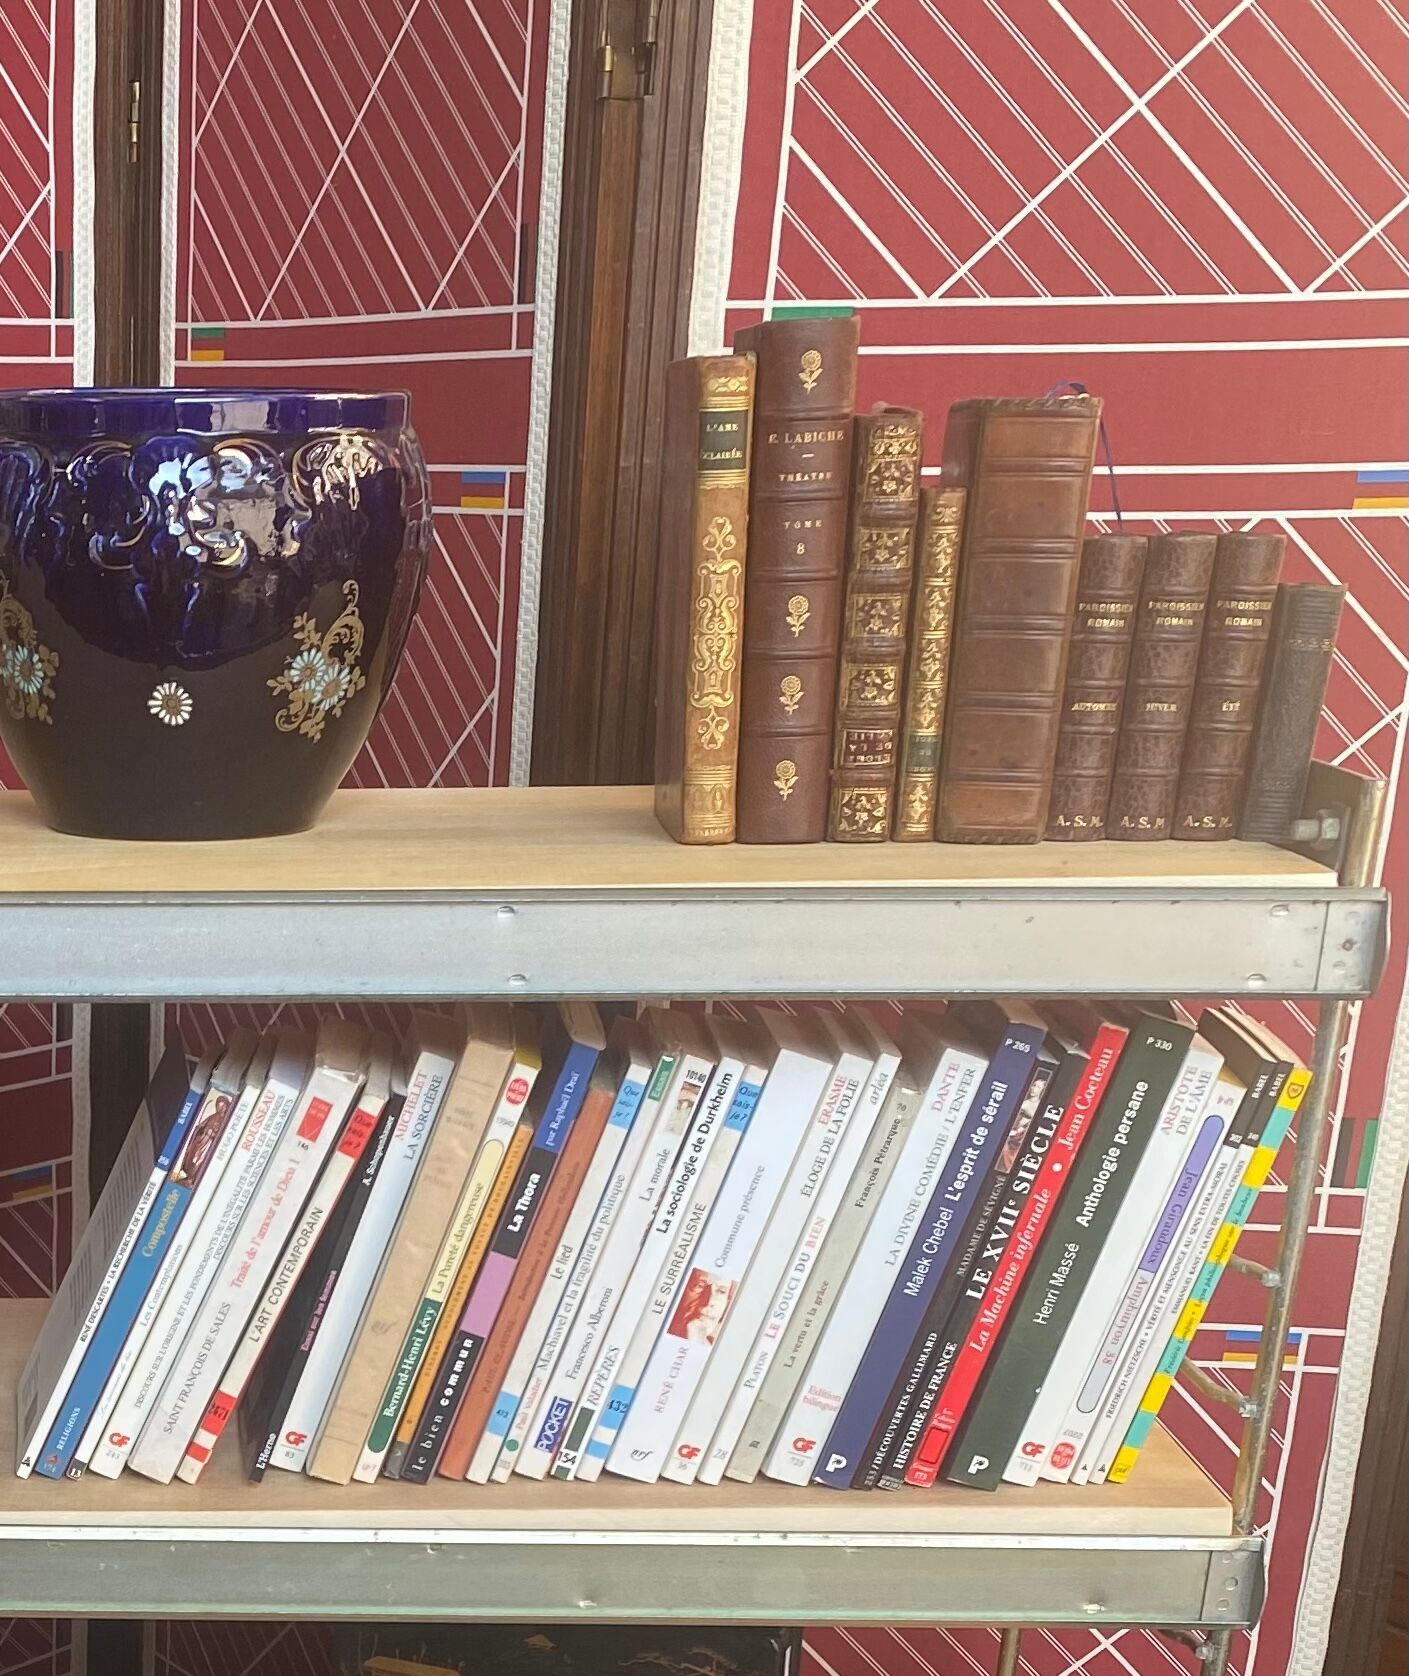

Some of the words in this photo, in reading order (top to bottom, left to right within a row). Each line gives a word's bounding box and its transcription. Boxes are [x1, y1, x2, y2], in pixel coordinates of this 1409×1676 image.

[785, 431, 844, 443] LABICHE
[797, 543, 805, 554] 8
[1088, 618, 1124, 628] ROMAIN
[1156, 616, 1194, 626] ROMAIN
[1225, 617, 1262, 626] ROMAIN
[1155, 1038, 1173, 1050] 330
[393, 1070, 428, 1140] MICHELET
[408, 1073, 444, 1141] SORCIÈRE
[930, 1061, 962, 1113] DANTE
[978, 1079, 1010, 1125] sérail
[1057, 1111, 1086, 1151] Jean
[1073, 1044, 1115, 1113] Cocteau
[1158, 1063, 1199, 1135] ARISTOTE
[240, 1088, 277, 1152] ROUSSEAU
[968, 1124, 990, 1147] de
[401, 1141, 418, 1161] LA
[655, 1216, 671, 1235] La
[663, 1153, 699, 1217] sociologie
[690, 1135, 706, 1153] de
[698, 1070, 734, 1135] Durkheim
[944, 1145, 981, 1202] L'esprit
[1074, 1144, 1123, 1228] Anthologie
[1109, 1078, 1151, 1145] persane
[514, 1171, 541, 1214] Thora
[139, 1186, 183, 1259] Compostelle
[507, 1212, 525, 1233] La
[920, 1205, 955, 1256] Chebel
[1008, 1185, 1053, 1262] infernale
[248, 1308, 273, 1343] L'ART
[267, 1206, 324, 1306] CONTEMPORAIN
[550, 1263, 566, 1280] Le
[555, 1243, 573, 1265] lied
[651, 1298, 666, 1315] LE
[659, 1202, 707, 1296] SURRÉALISME
[902, 1253, 933, 1297] Malek
[86, 1284, 110, 1324] DESCARTES
[979, 1260, 1021, 1329] Machine
[1032, 1275, 1066, 1327] Henri
[1052, 1240, 1080, 1277] Massé
[208, 1301, 232, 1336] SALES
[968, 1328, 991, 1353] La
[201, 1335, 216, 1352] DE
[383, 1335, 426, 1419] Bernard-Henri
[415, 1304, 438, 1336] Lévy
[176, 1350, 208, 1403] FRANÇOIS
[585, 1344, 620, 1406] REPÈRES
[872, 1392, 912, 1466] DÉCOUVERTES
[904, 1330, 939, 1393] GALLIMARD
[55, 1406, 81, 1450] RELIGIONS
[162, 1403, 184, 1434] SAINT
[534, 1396, 571, 1452] POCKET
[255, 1431, 277, 1469] L'Herne
[560, 1452, 576, 1465] 154
